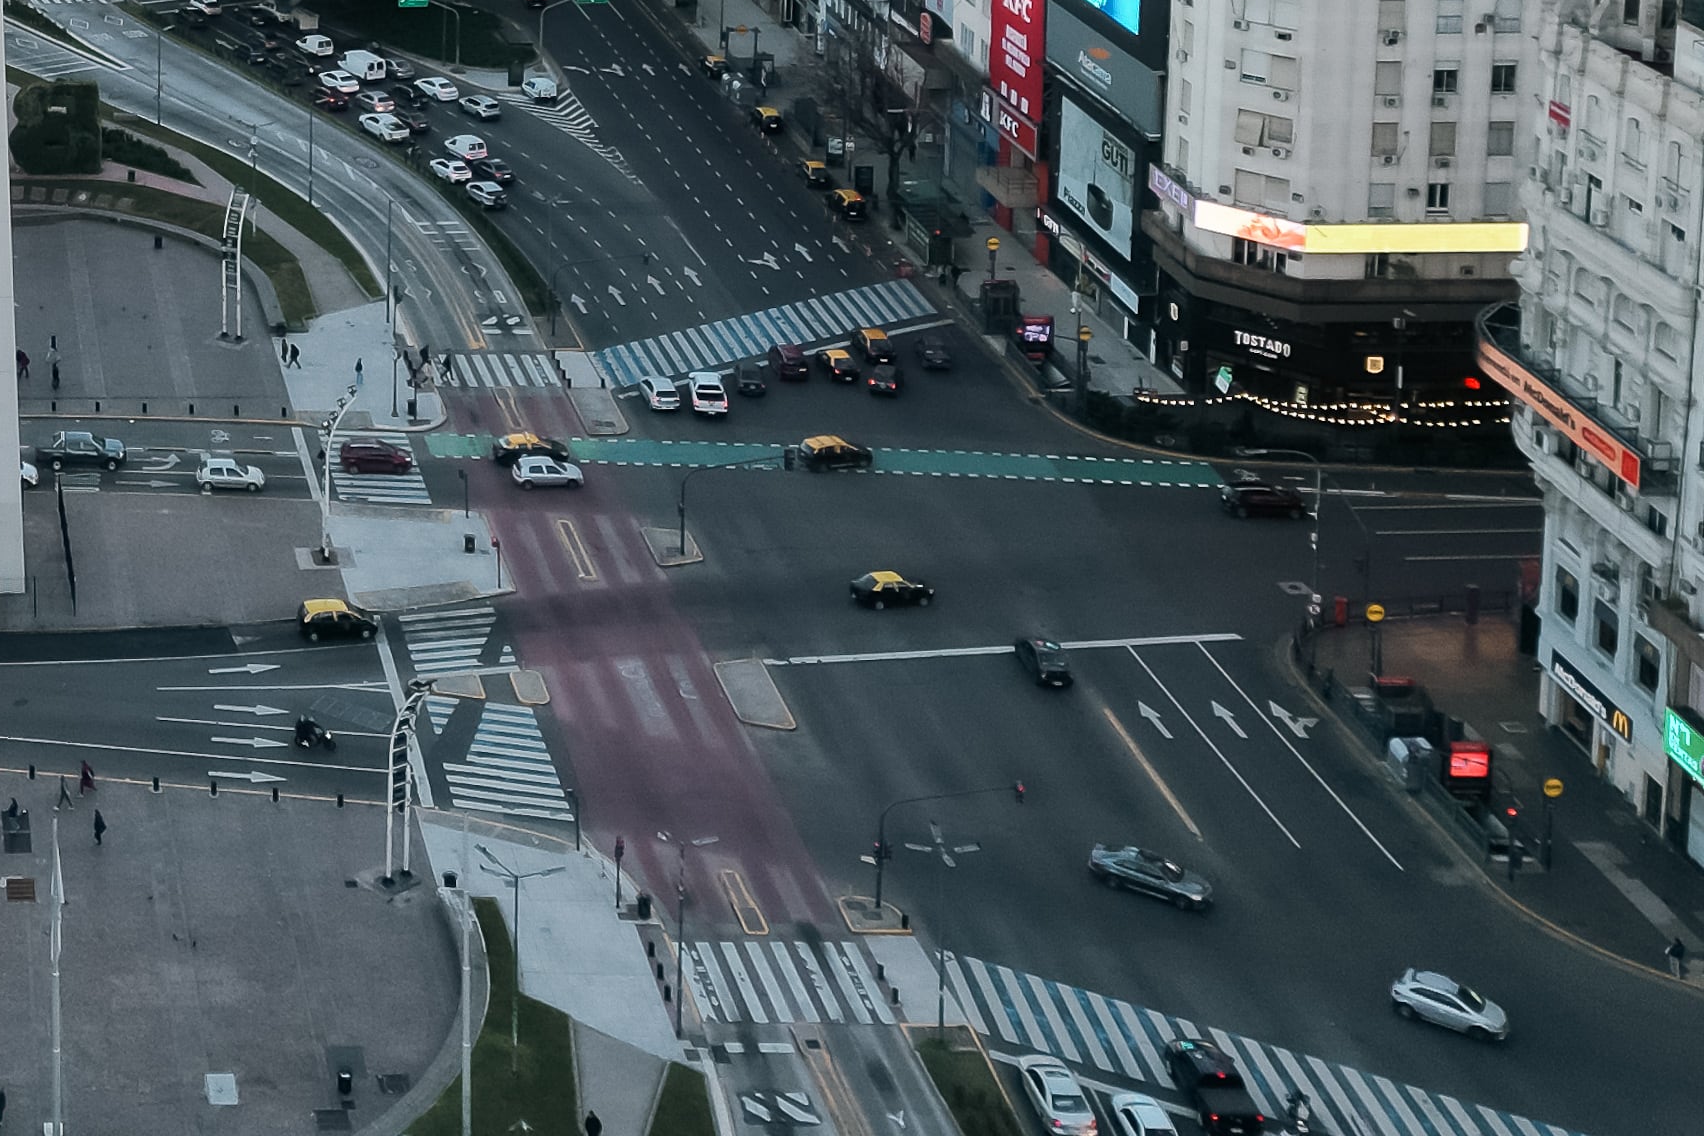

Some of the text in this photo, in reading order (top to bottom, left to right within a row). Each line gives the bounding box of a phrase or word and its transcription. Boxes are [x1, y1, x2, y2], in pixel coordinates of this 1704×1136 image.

[999, 110, 1019, 138] KFC
[1234, 330, 1292, 358] TOSTADO
[1554, 662, 1608, 720] McDonald's
